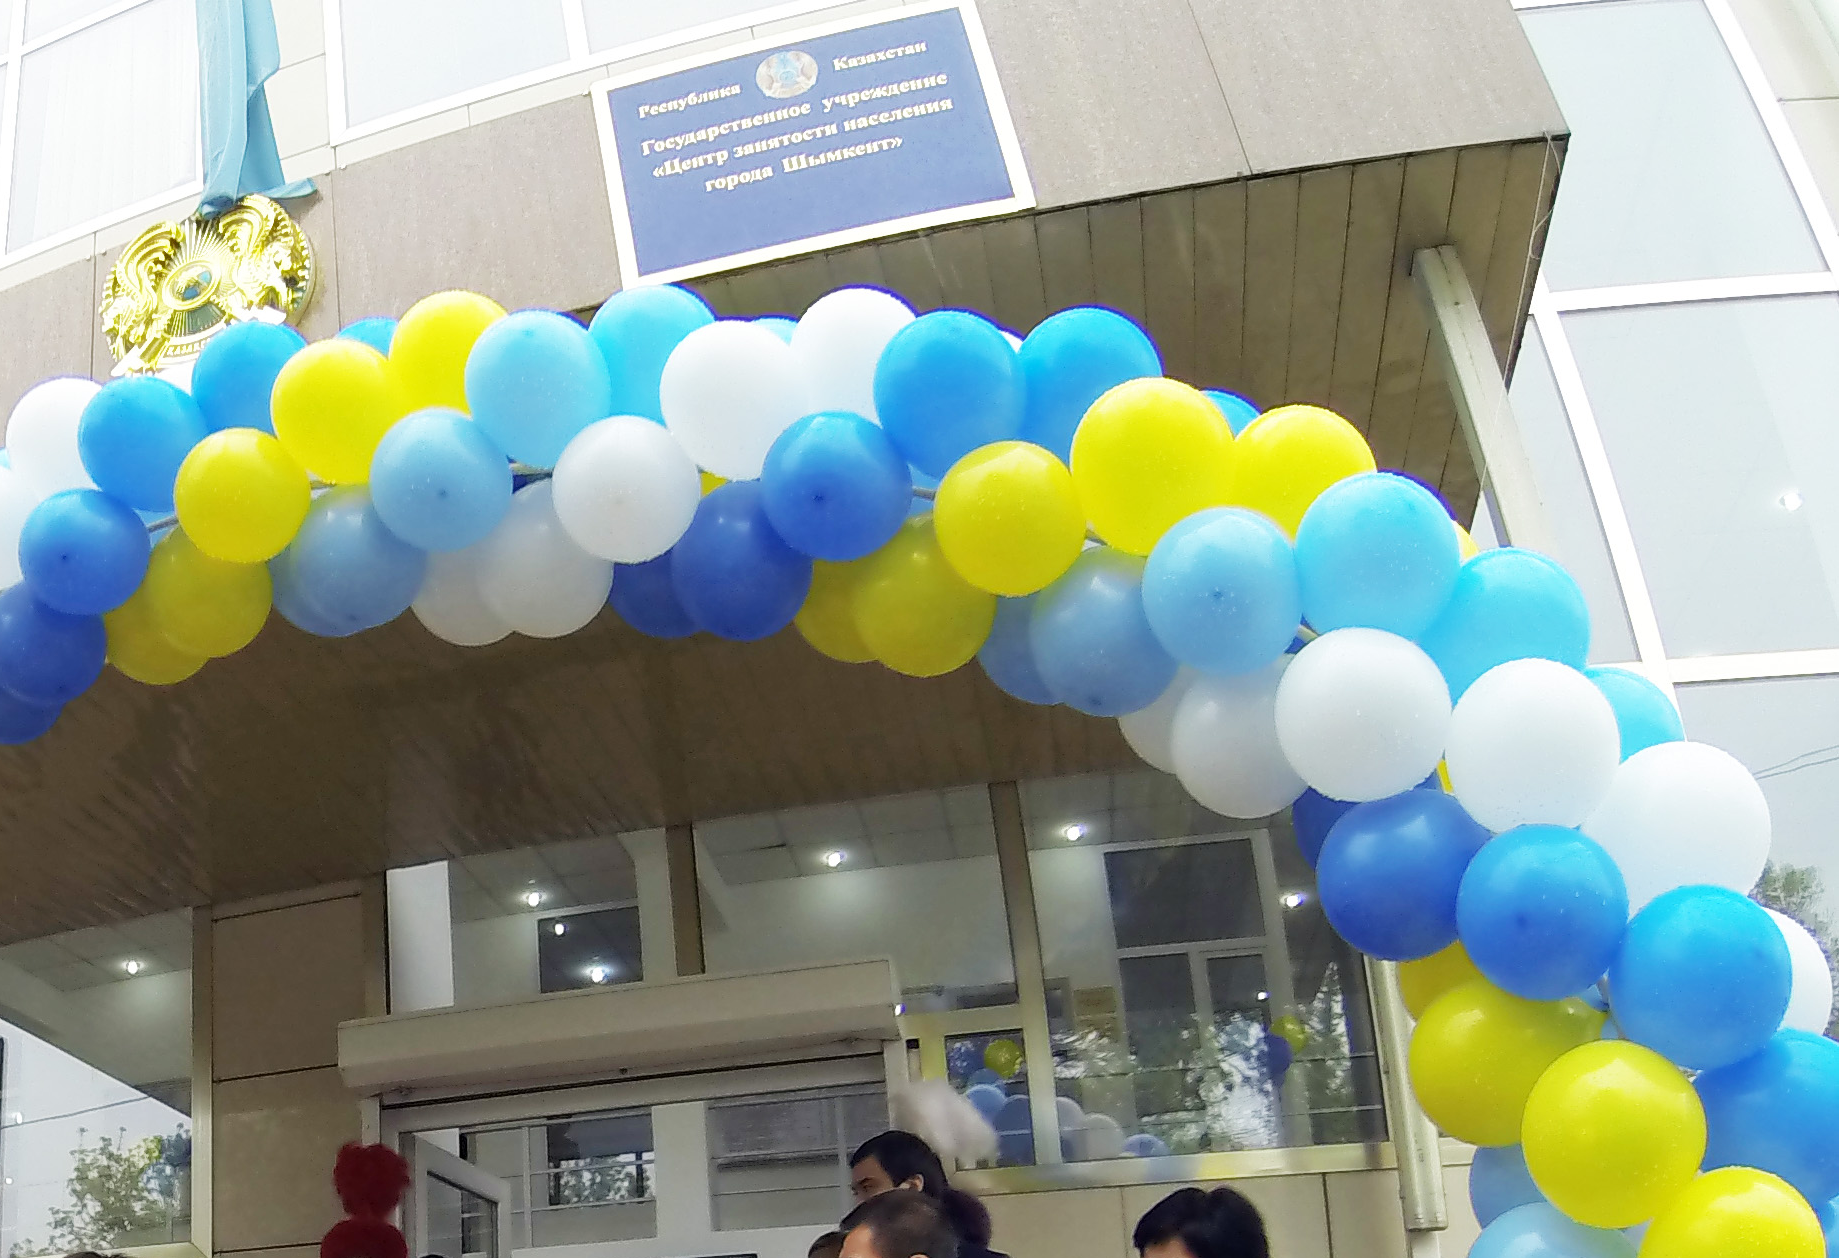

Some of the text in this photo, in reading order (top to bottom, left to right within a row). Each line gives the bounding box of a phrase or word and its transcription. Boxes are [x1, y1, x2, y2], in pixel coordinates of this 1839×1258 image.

[637, 40, 928, 120] Республика Казахстан
[640, 72, 949, 157] Государственное учреждение
[651, 97, 954, 181] «Центр занятости населения
[704, 135, 904, 193] города Шымкент»
